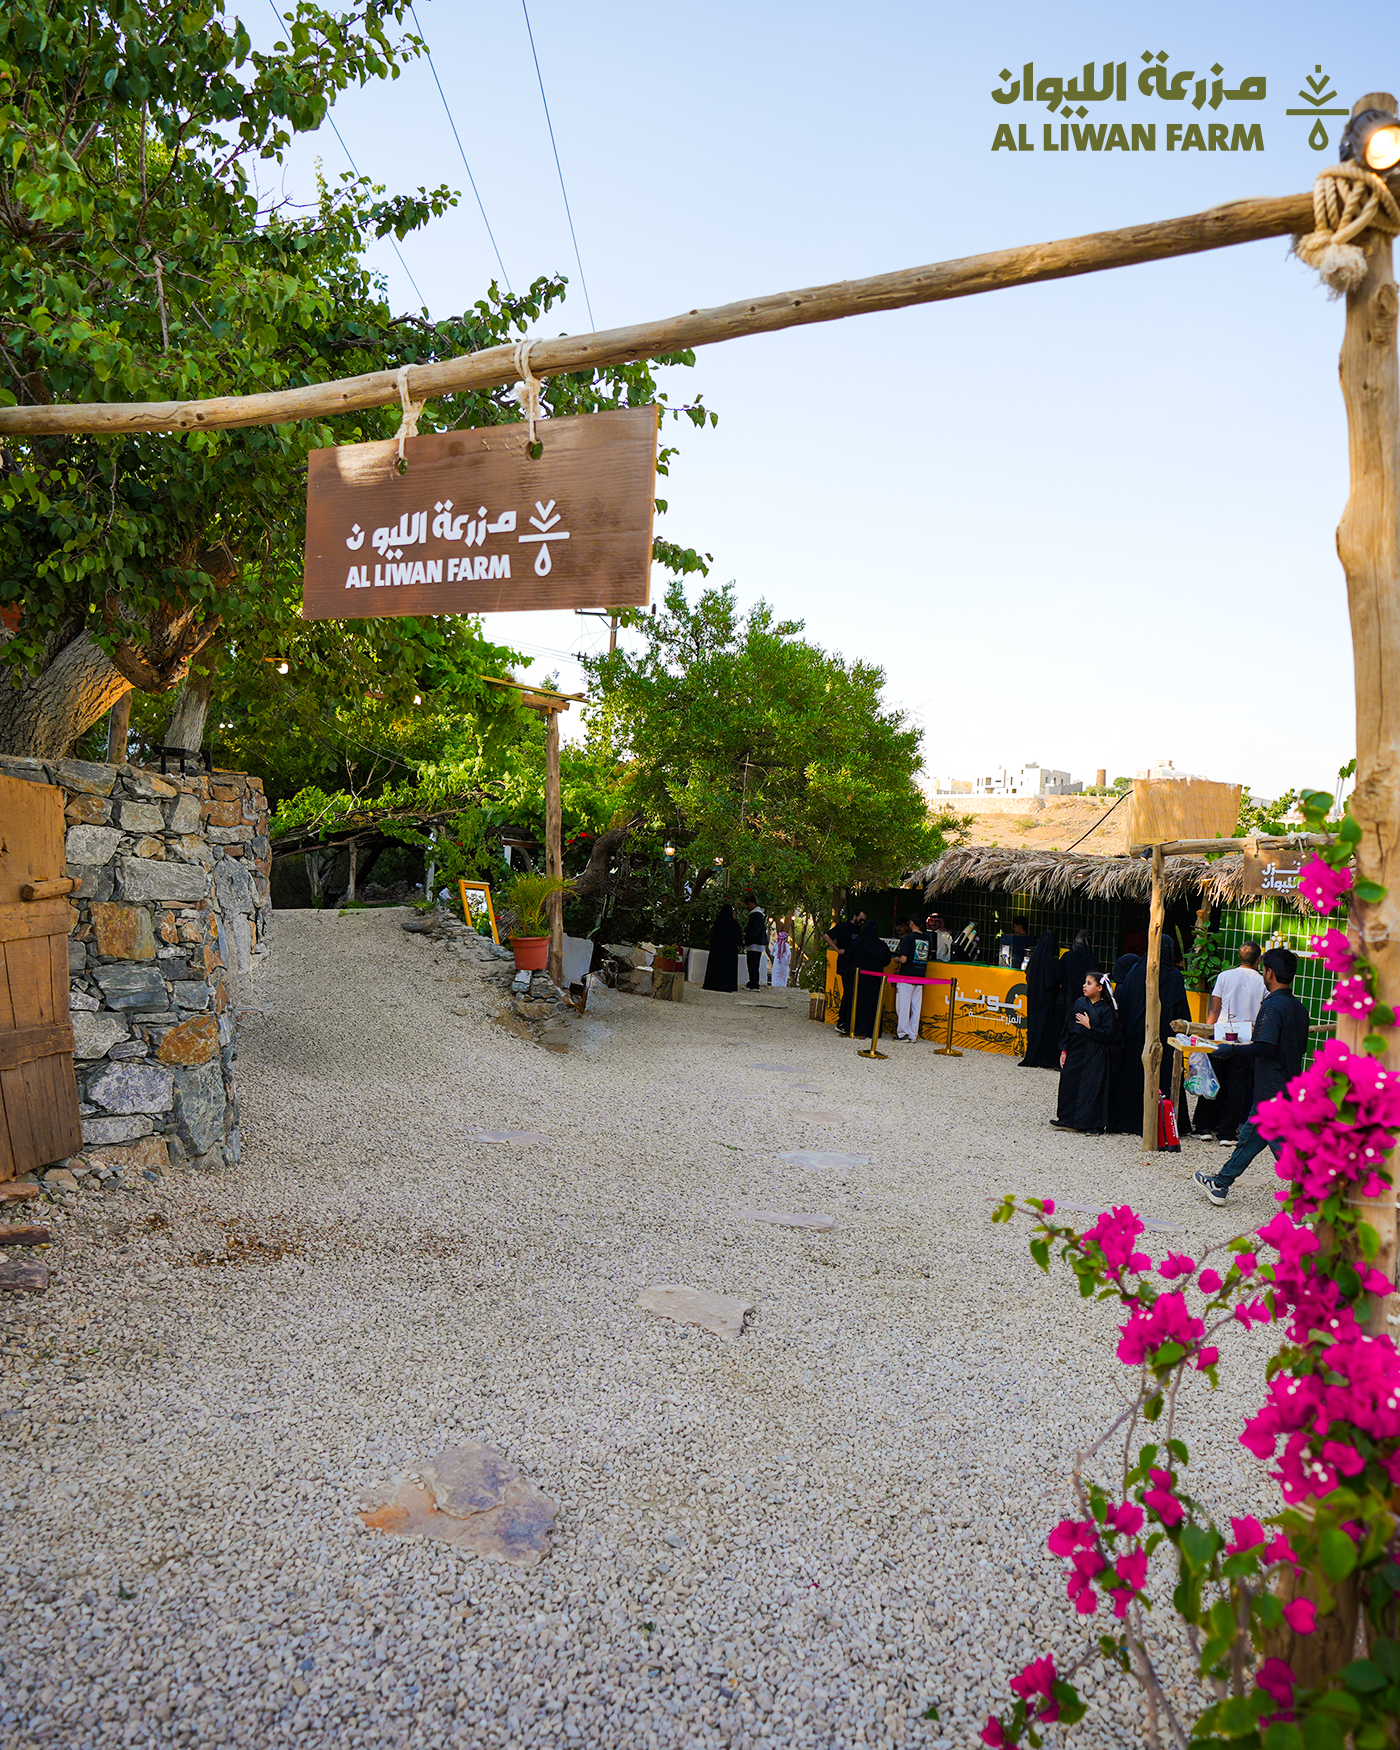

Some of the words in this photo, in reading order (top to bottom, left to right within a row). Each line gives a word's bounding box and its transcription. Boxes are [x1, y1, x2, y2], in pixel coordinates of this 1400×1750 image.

[432, 499, 517, 548] مزرعة
[345, 564, 371, 589] AL
[374, 559, 443, 587] LIWAN
[447, 554, 512, 582] FARM
